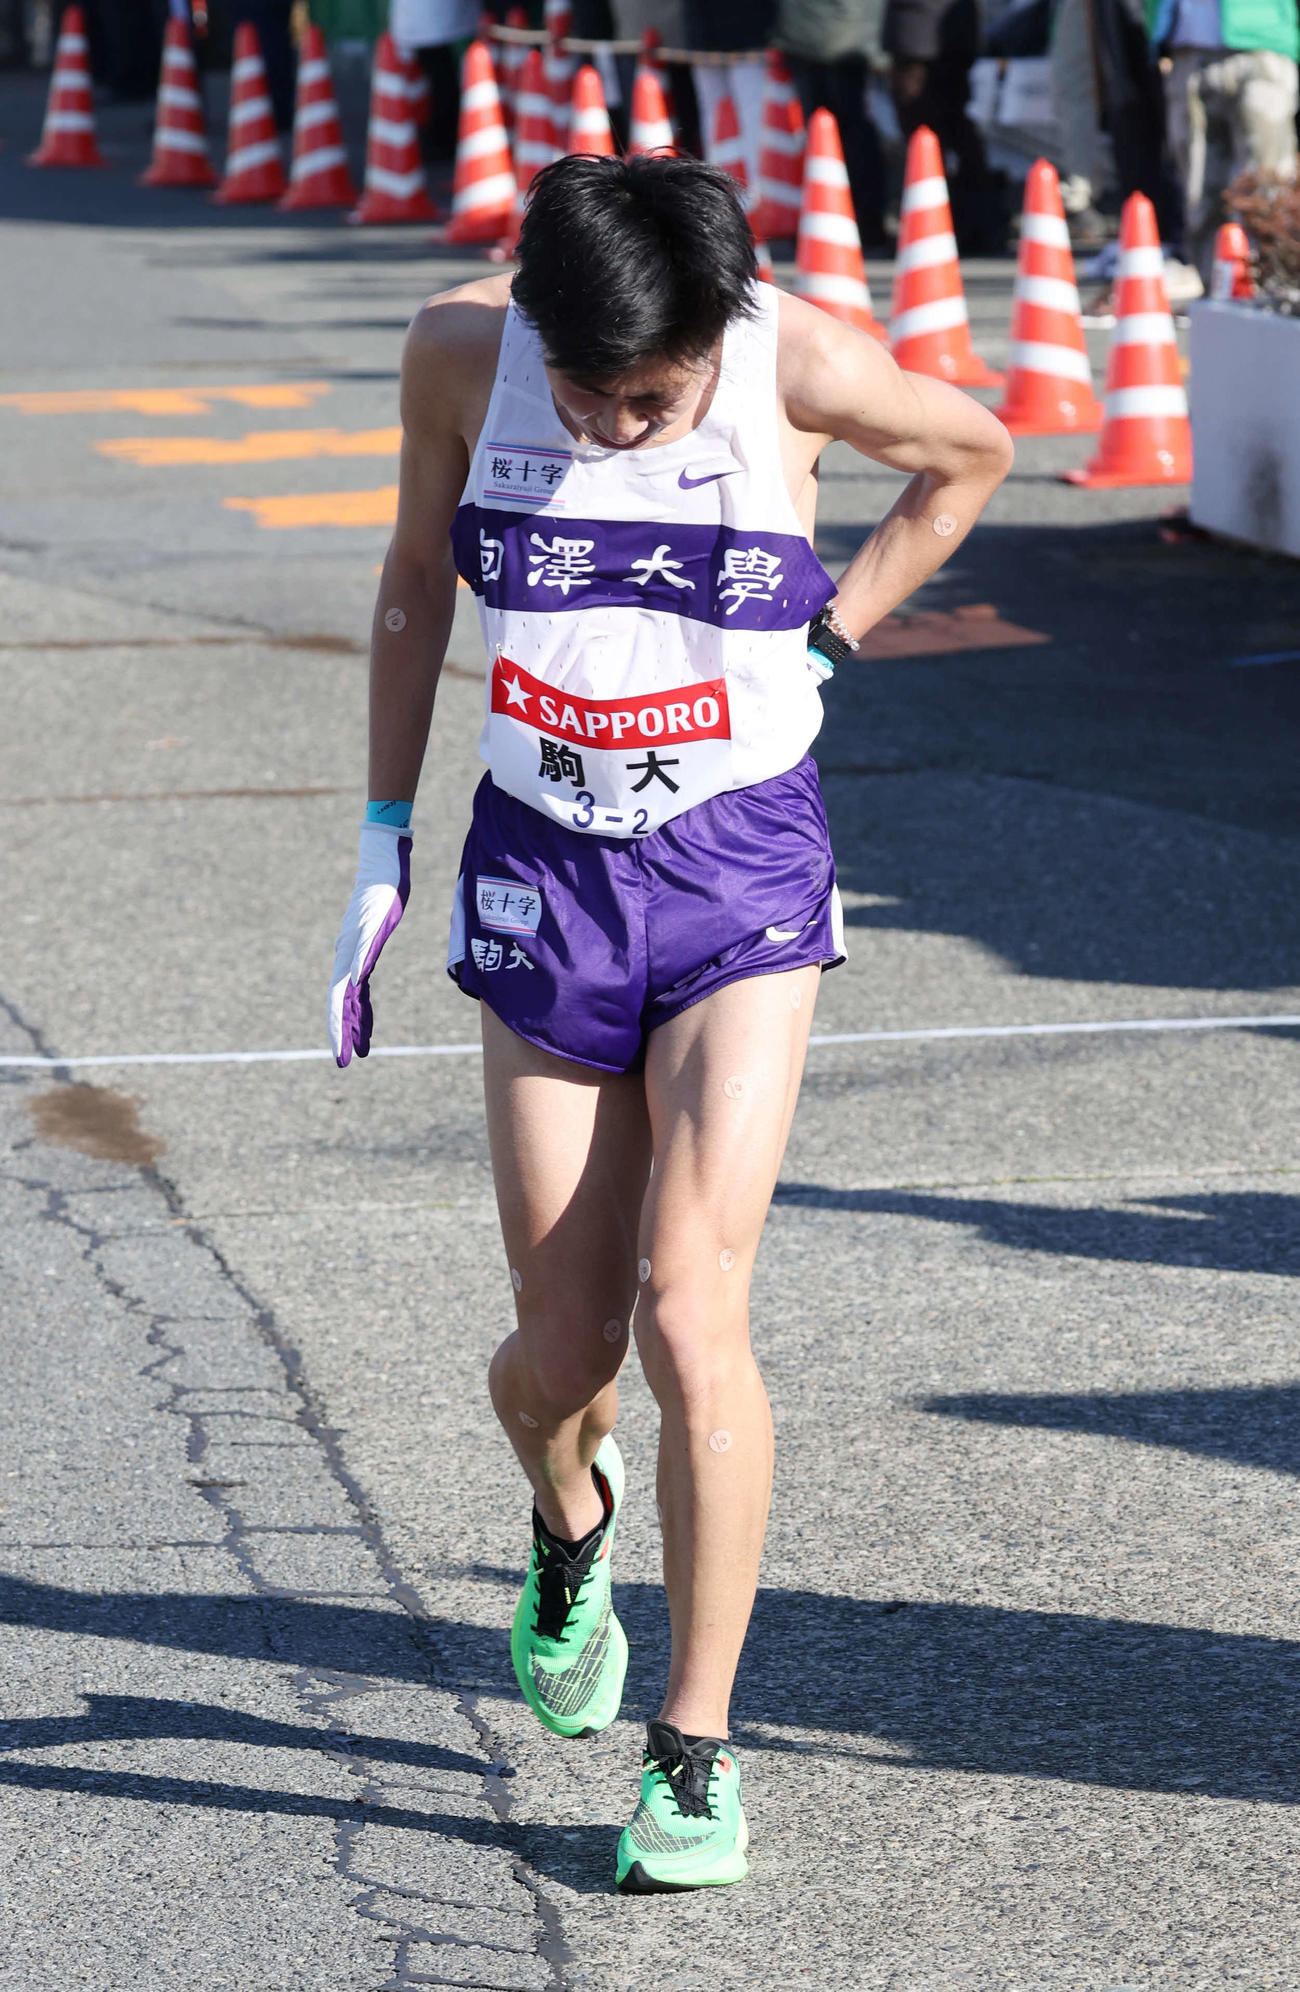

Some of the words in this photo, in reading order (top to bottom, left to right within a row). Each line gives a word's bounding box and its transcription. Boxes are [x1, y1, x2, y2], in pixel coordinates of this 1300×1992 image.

[491, 456, 563, 485] 桜十字
[538, 694, 720, 740] SAPPORO
[538, 736, 681, 794] 駒大
[572, 790, 649, 835] 3-2
[480, 889, 537, 916] 桜十字
[470, 938, 535, 973] 駒大
